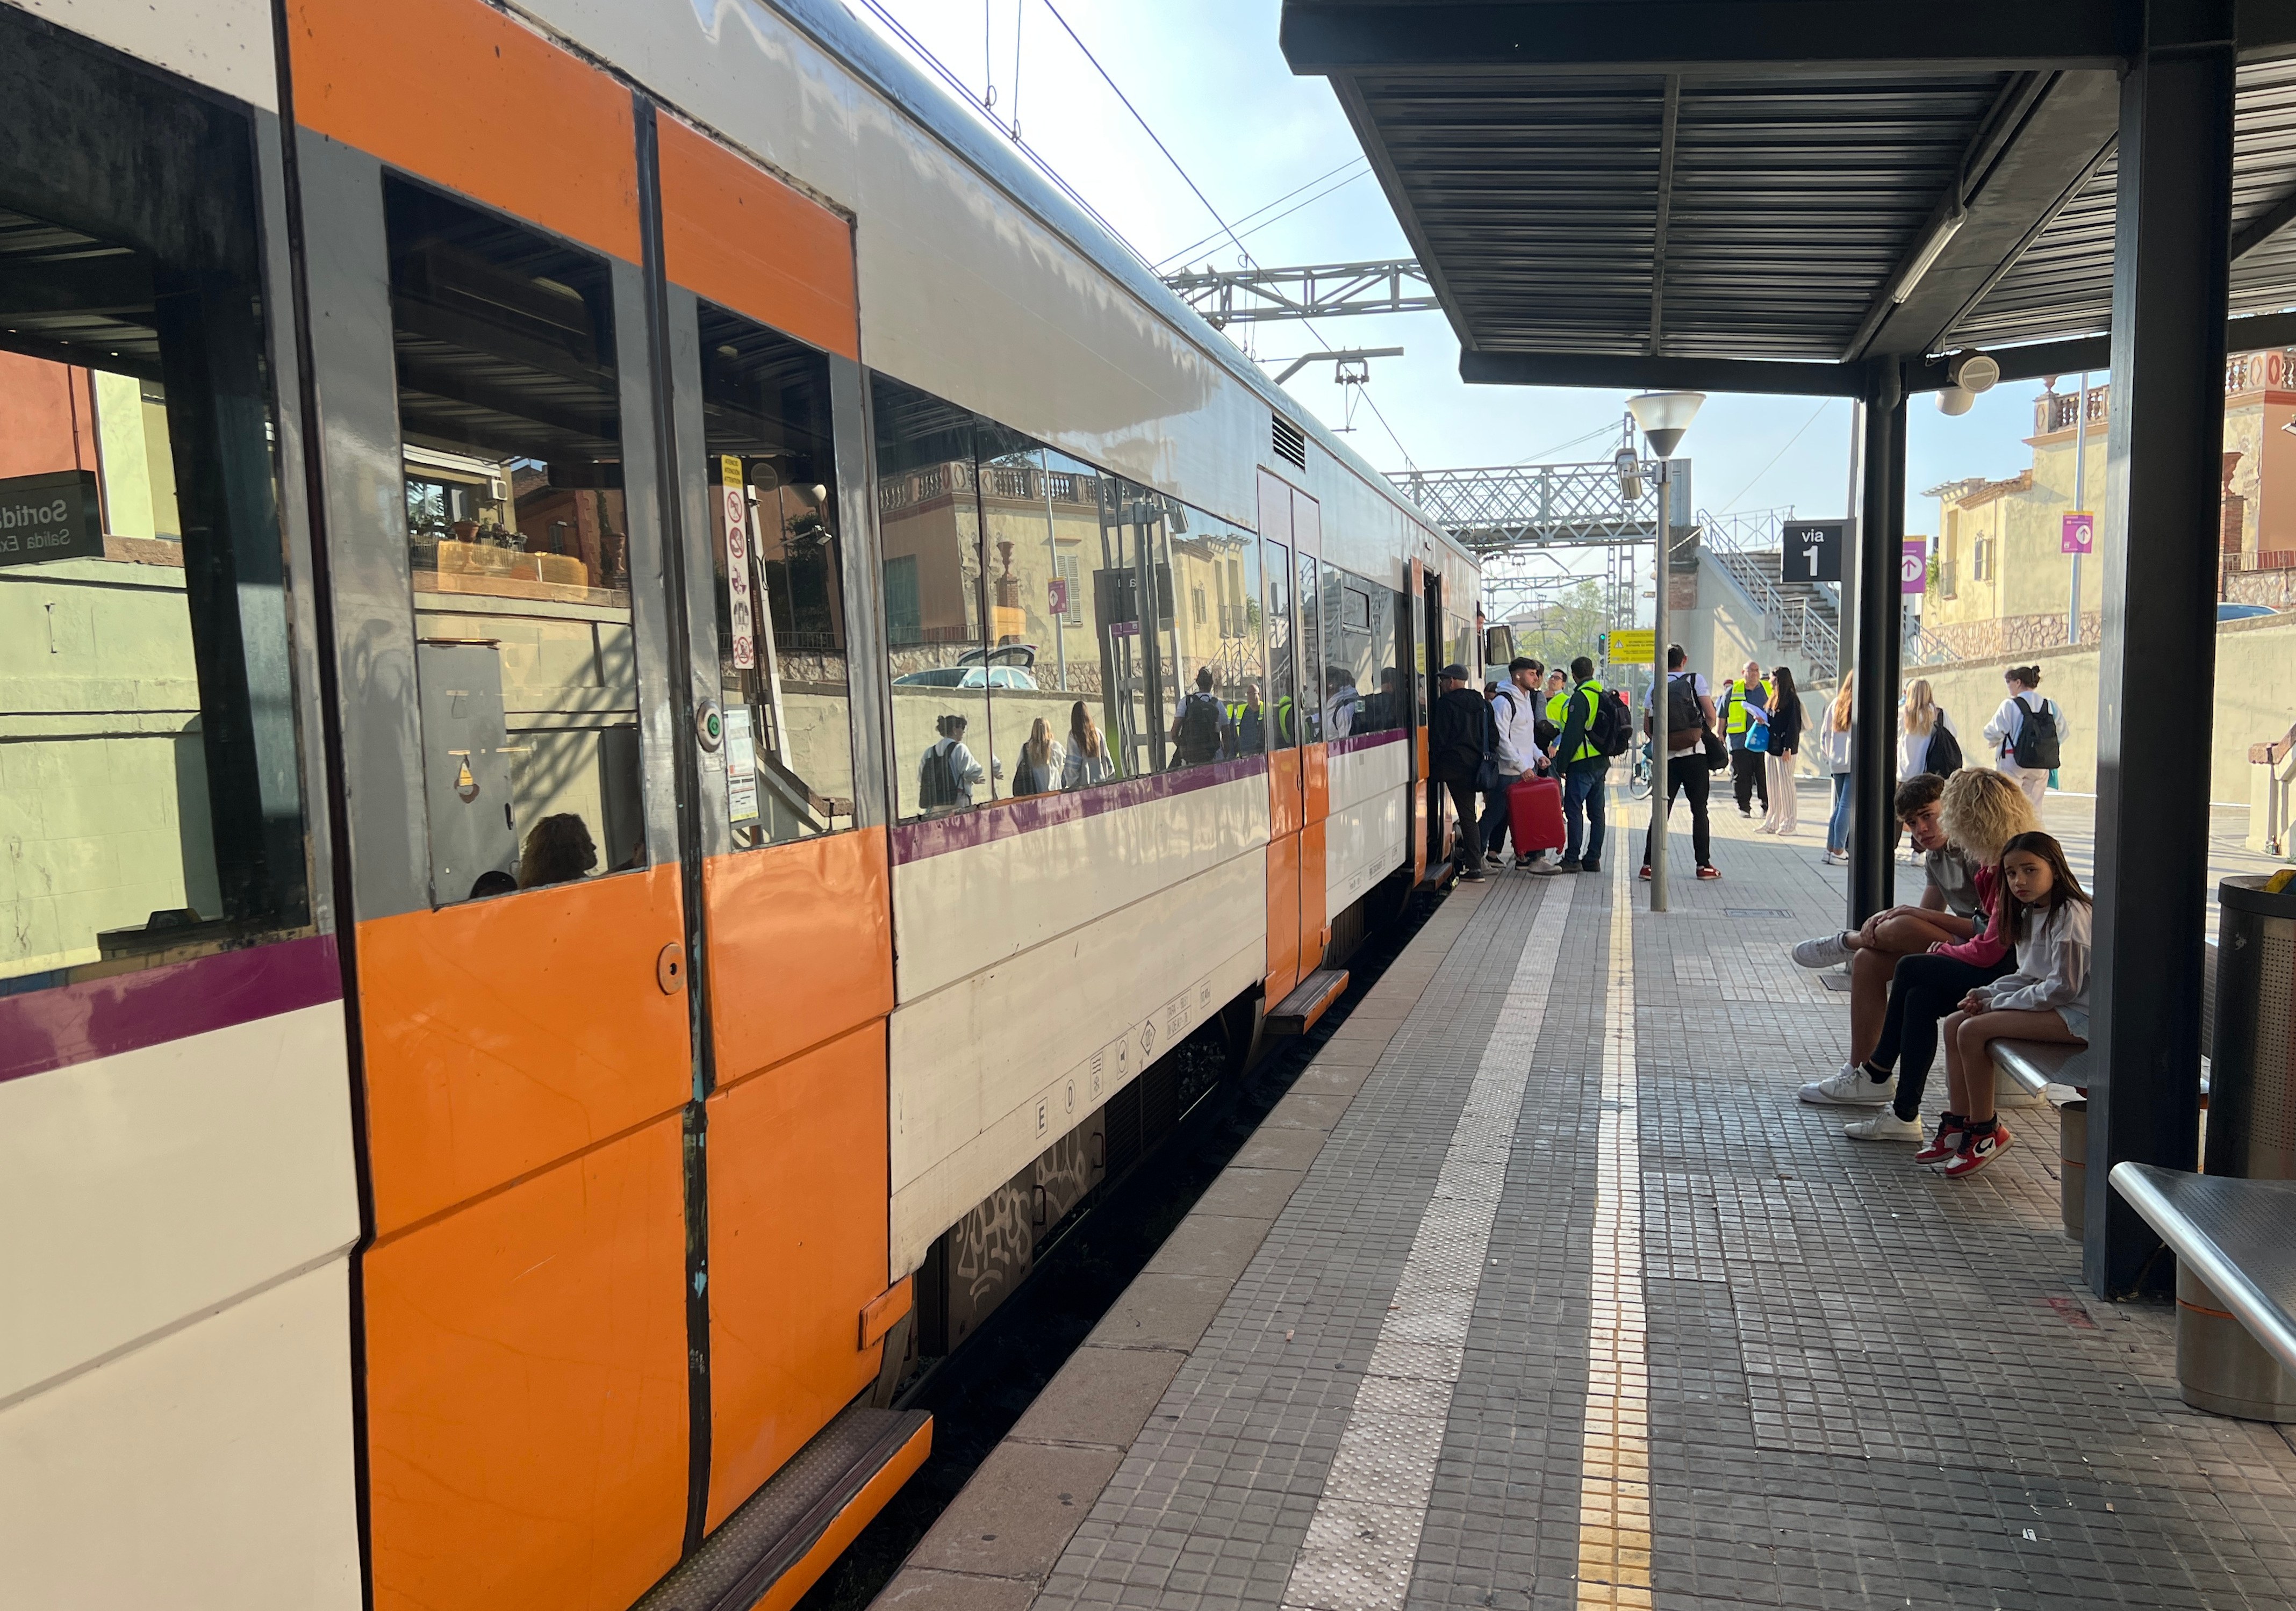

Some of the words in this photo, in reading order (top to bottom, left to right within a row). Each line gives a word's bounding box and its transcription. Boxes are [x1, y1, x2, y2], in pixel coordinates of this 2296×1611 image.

[1802, 529, 1824, 542] via
[1803, 545, 1818, 577] 1
[1068, 1086, 1073, 1107] D
[1039, 1105, 1045, 1130] E
